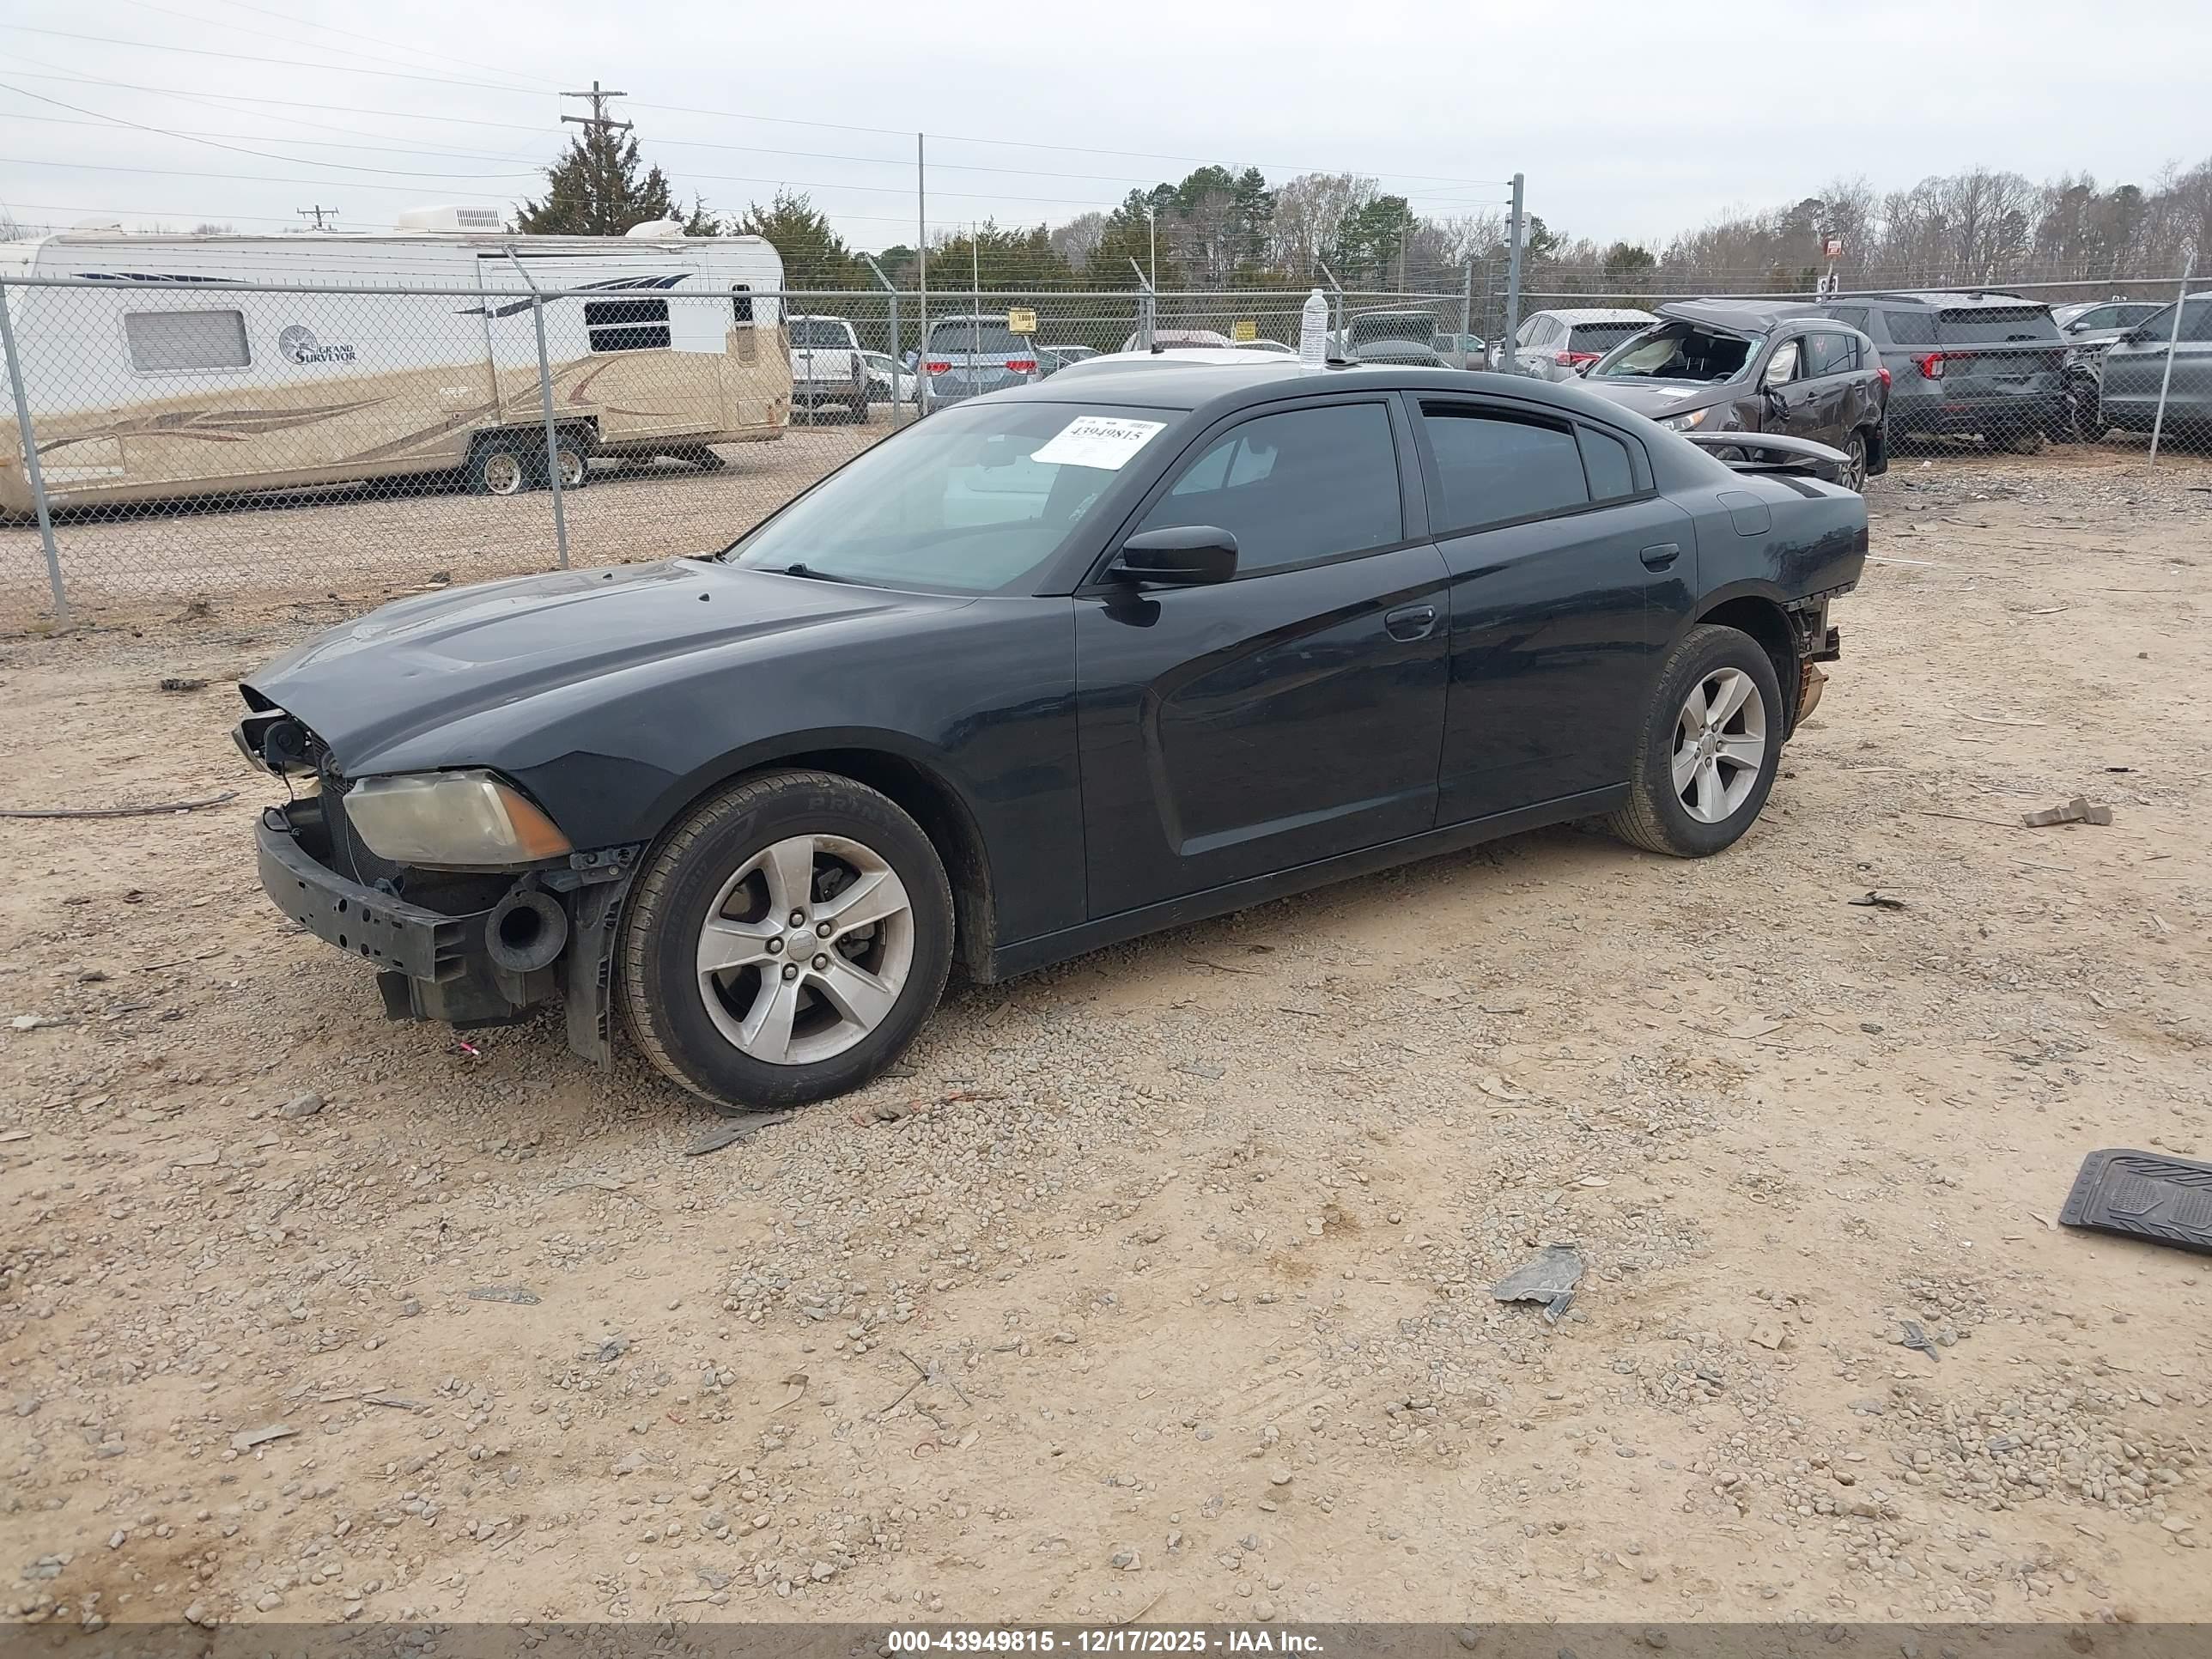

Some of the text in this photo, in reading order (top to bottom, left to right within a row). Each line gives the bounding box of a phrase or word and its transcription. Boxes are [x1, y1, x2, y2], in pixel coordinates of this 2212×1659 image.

[319, 344, 354, 354] GRAND
[295, 350, 357, 363] SURVEYOR
[1070, 426, 1143, 441] 43949815
